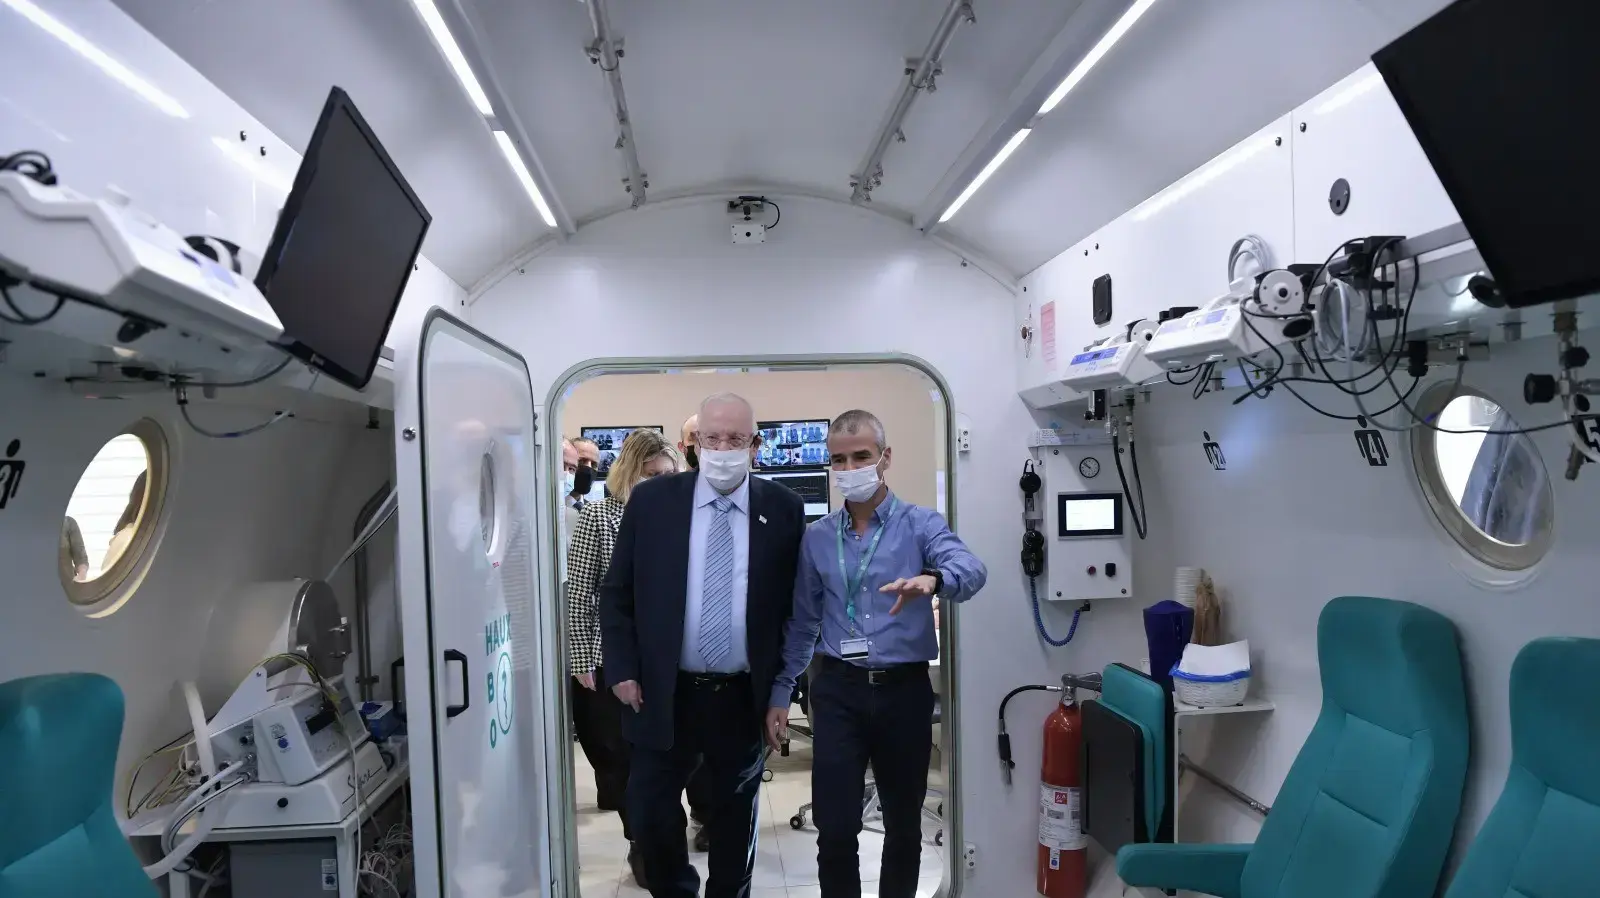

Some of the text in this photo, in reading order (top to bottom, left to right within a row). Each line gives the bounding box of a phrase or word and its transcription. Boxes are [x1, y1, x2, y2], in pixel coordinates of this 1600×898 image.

[1367, 434, 1382, 464] 4
[1583, 419, 1600, 457] 5
[485, 612, 512, 656] HAUX
[487, 672, 495, 703] B
